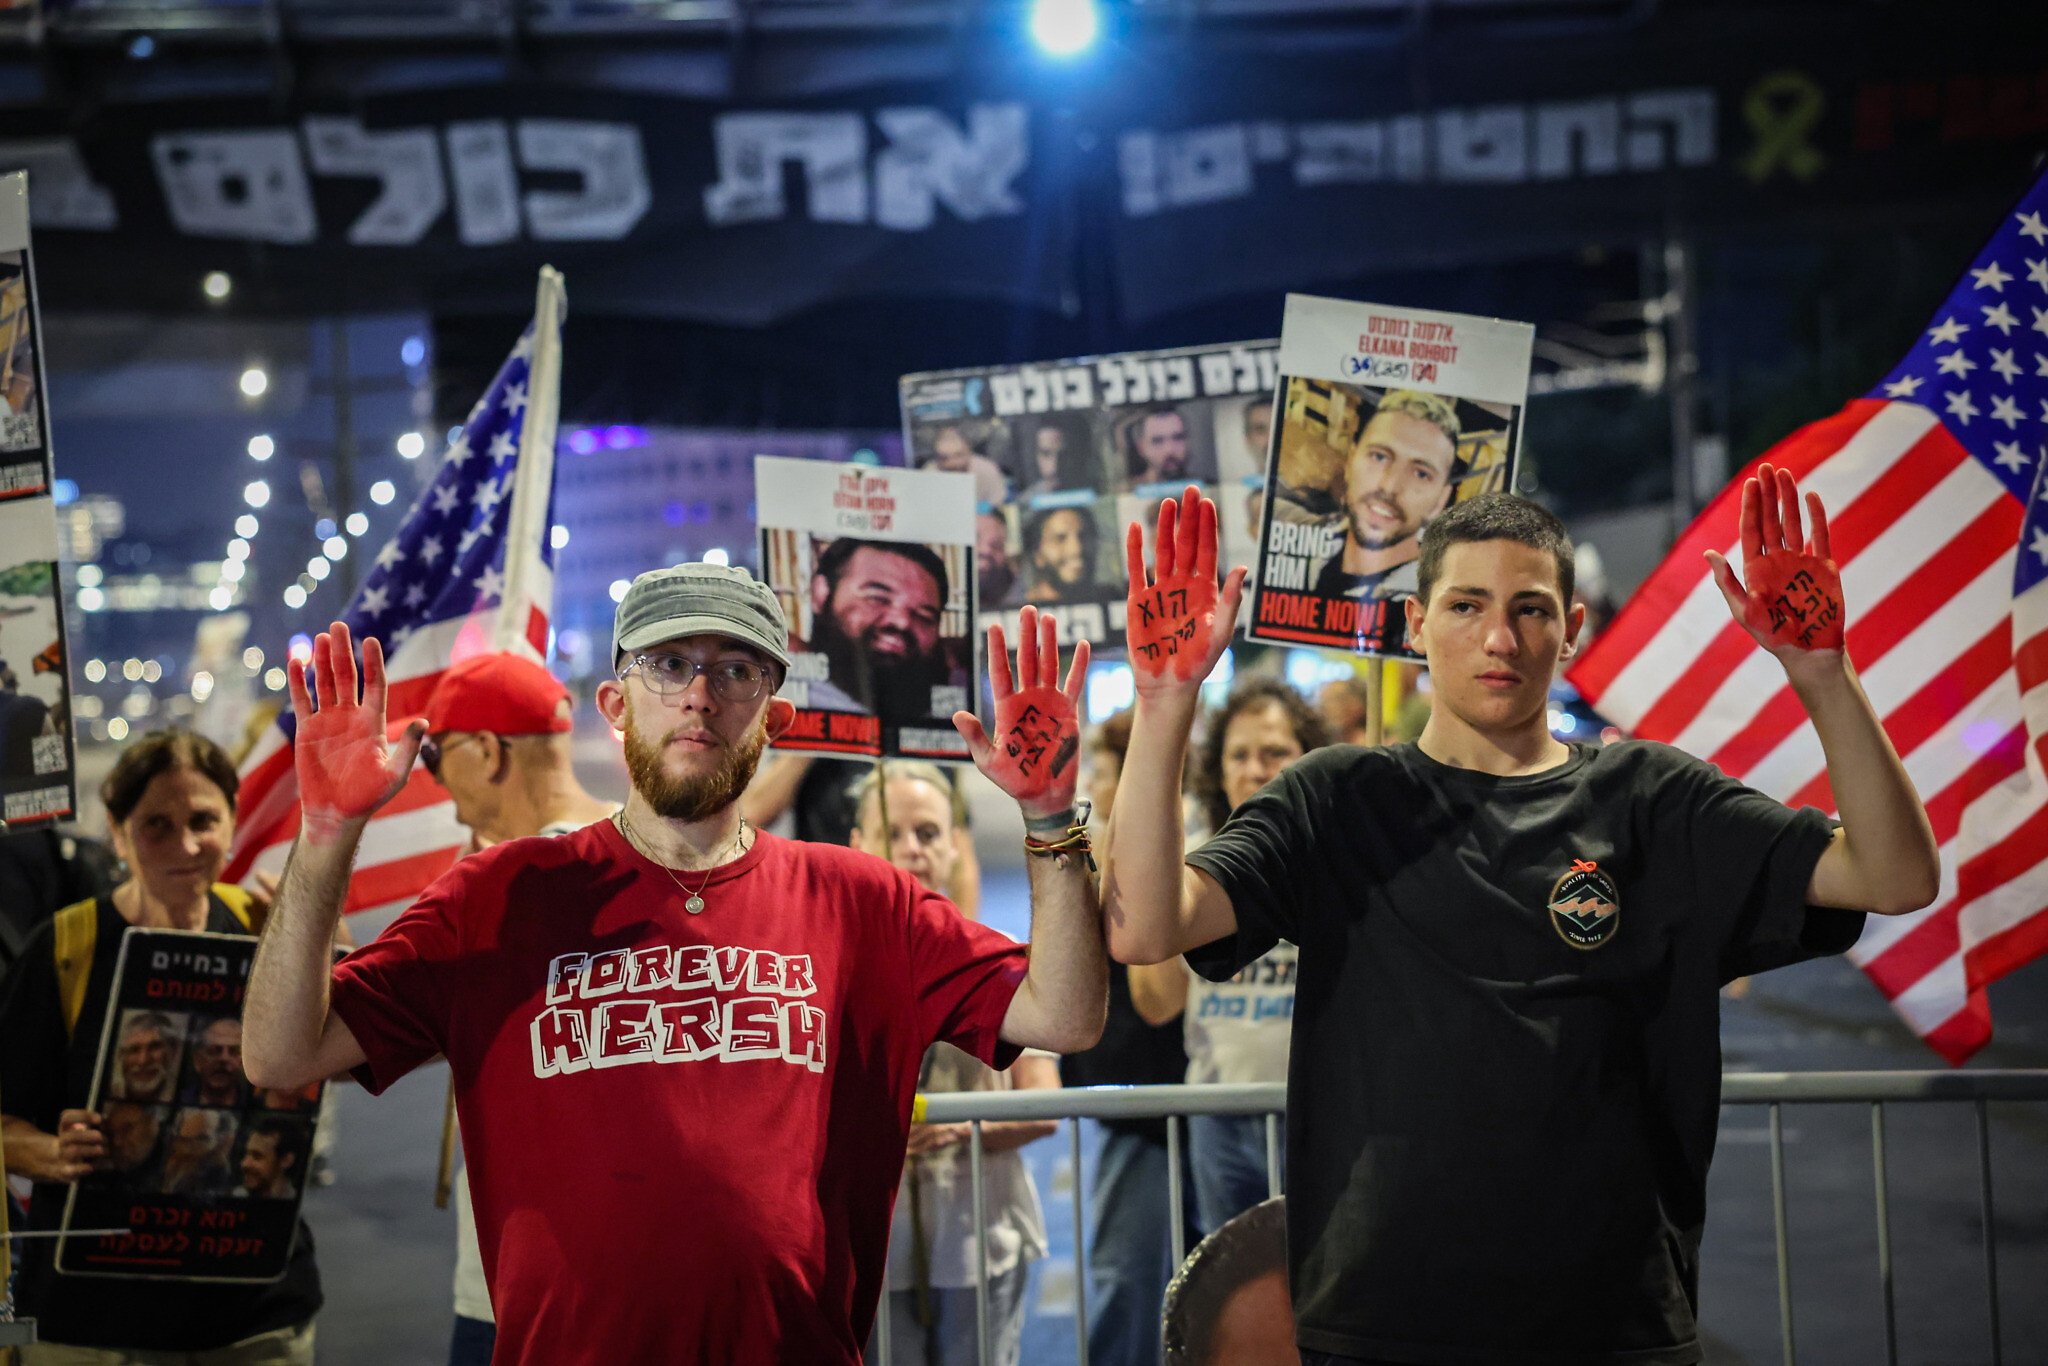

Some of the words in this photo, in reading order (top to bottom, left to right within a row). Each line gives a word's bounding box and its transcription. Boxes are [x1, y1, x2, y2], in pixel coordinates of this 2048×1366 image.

[149, 114, 652, 246] כולם
[702, 101, 1030, 231] את
[1200, 345, 1278, 397] ולם
[1358, 333, 1405, 357] ELKANA
[1408, 341, 1458, 364] BOHBOT
[1268, 519, 1334, 559] BRING
[1263, 553, 1307, 591] HIM
[1259, 591, 1323, 629] HOME
[1323, 599, 1387, 637] NOW!
[151, 950, 228, 976] בחיים
[546, 945, 818, 1006] FOREVER
[530, 997, 826, 1079] HERSH
